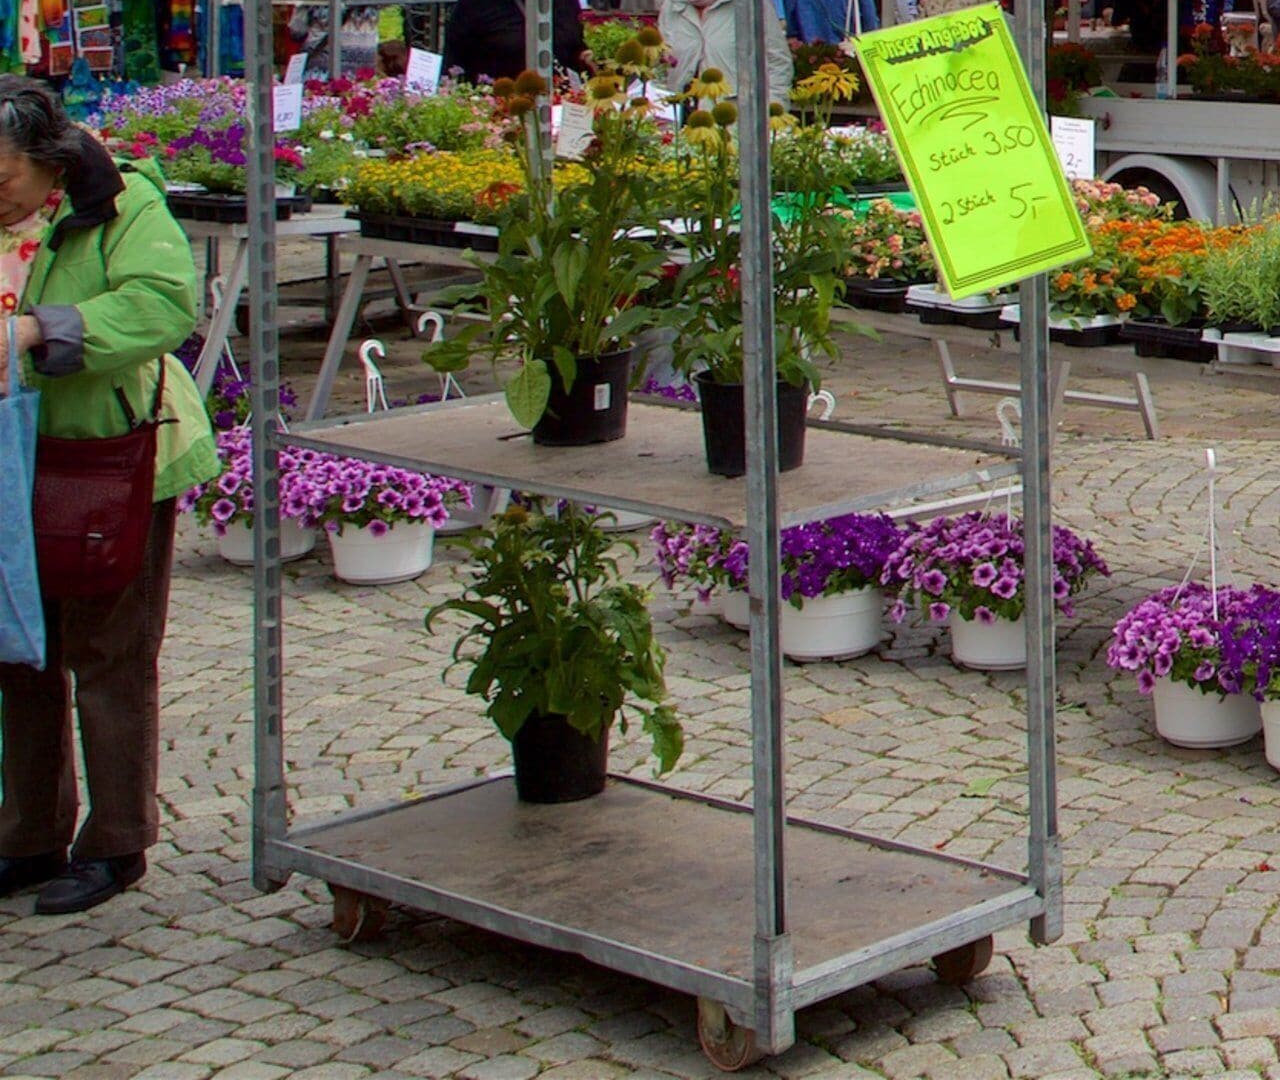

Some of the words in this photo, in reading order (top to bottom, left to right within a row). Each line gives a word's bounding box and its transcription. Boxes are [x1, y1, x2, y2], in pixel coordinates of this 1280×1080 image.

[875, 34, 923, 64] Unser
[920, 17, 992, 53] Angebot
[983, 126, 1035, 156] 3,50
[940, 203, 955, 225] 2
